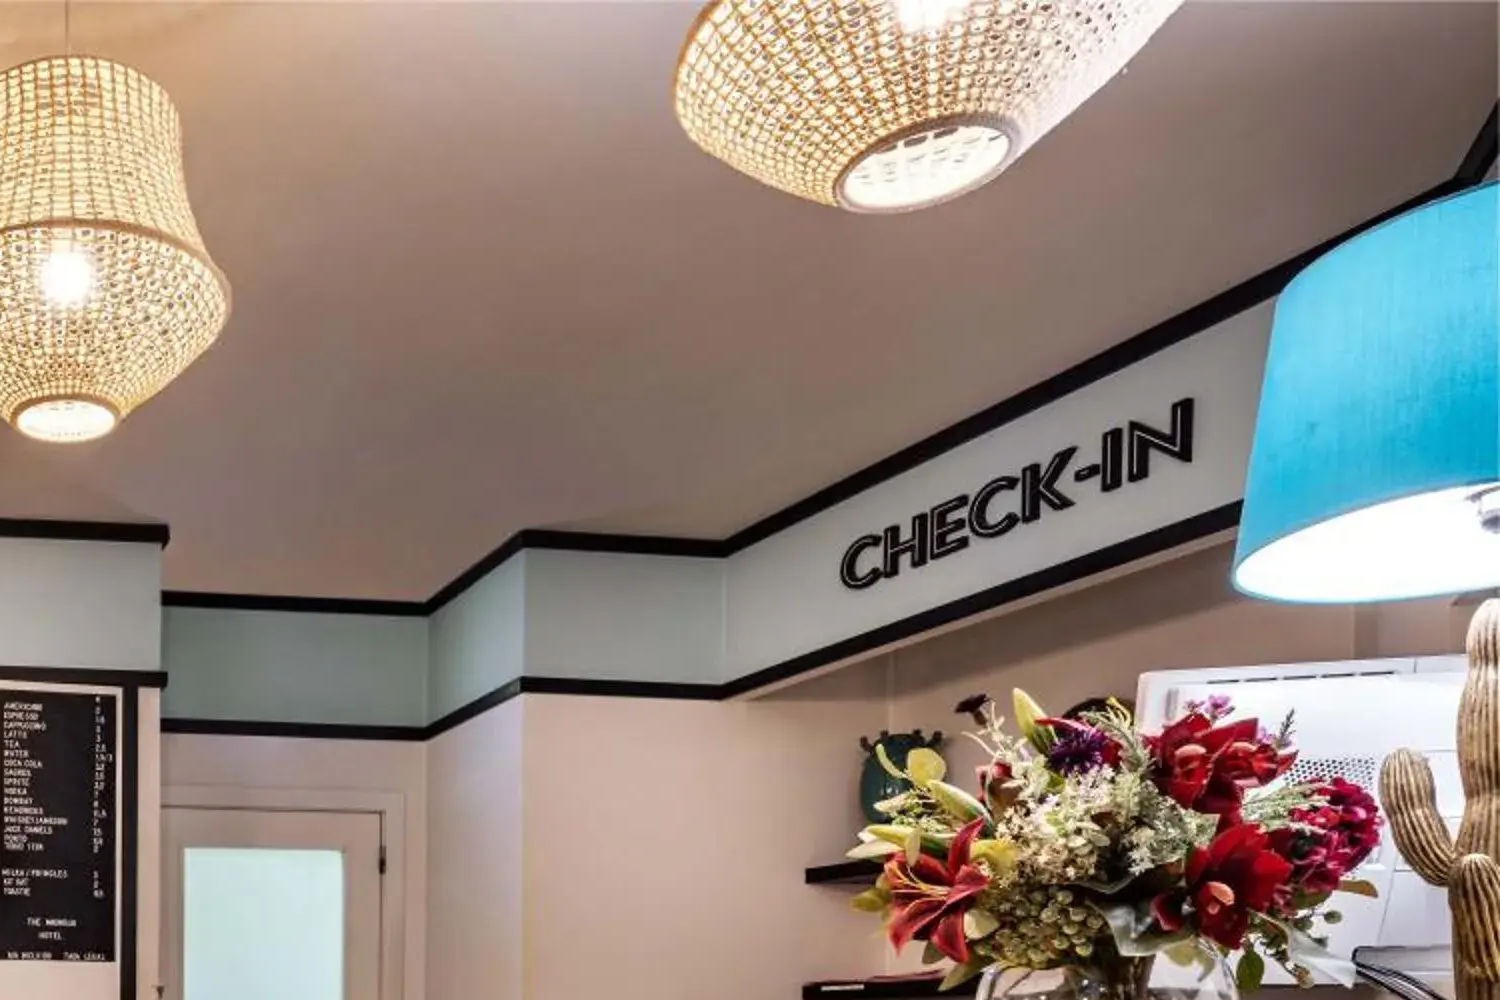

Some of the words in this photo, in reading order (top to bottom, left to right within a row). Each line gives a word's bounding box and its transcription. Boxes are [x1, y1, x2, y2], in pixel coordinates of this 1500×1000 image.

[839, 397, 1195, 591] CHECK-IN
[3, 740, 21, 749] TEA
[3, 759, 22, 768] COCA
[23, 760, 43, 769] COLA
